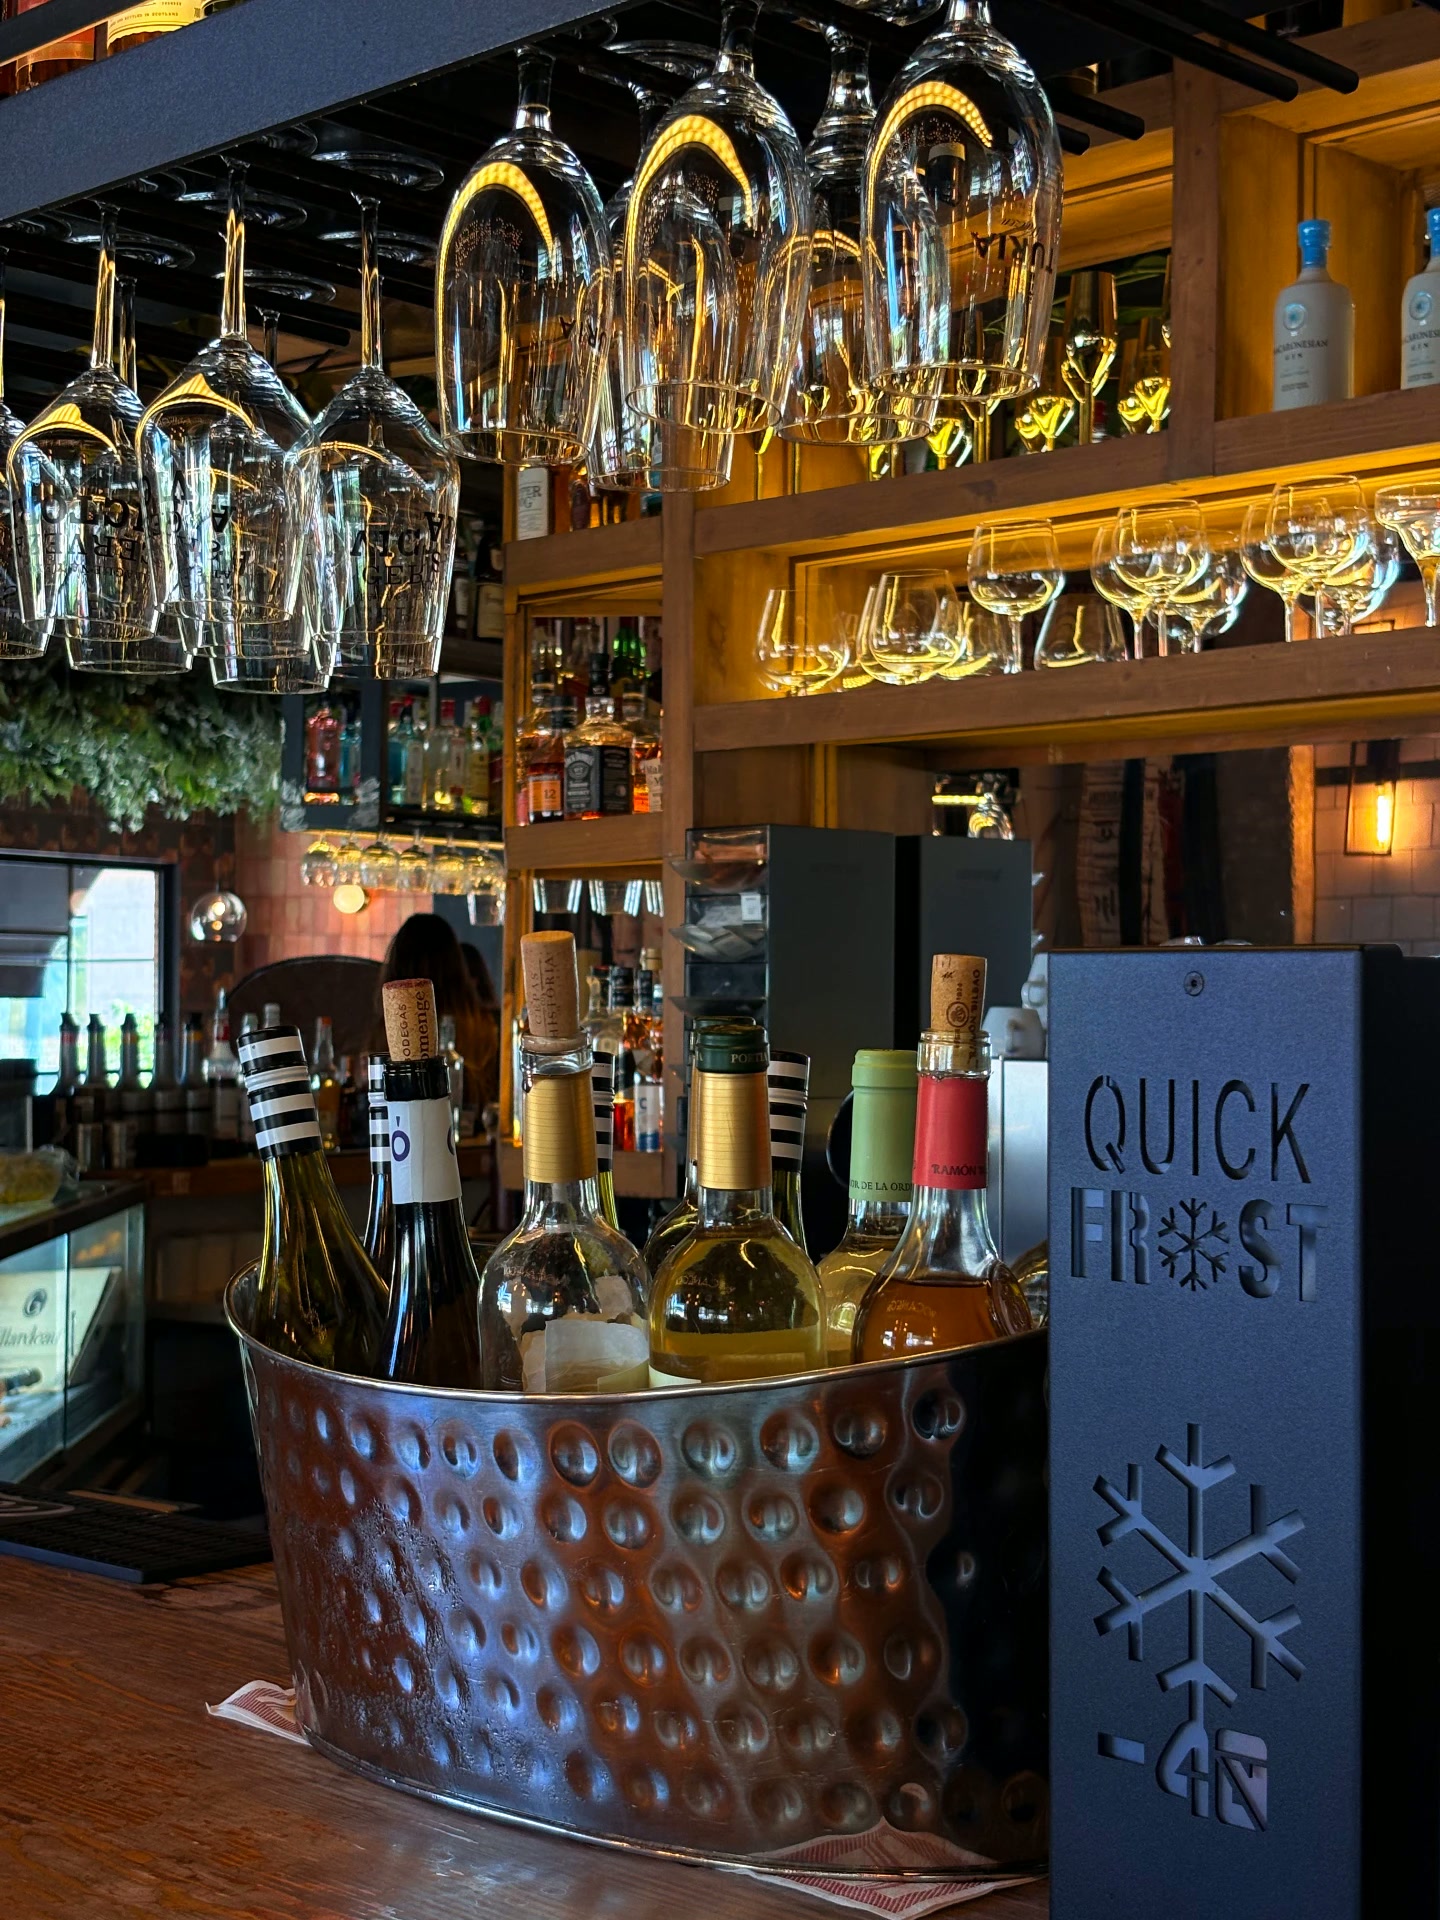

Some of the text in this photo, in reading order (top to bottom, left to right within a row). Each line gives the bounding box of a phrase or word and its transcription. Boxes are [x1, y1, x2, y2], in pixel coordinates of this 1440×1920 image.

[543, 788, 557, 800] 12
[530, 972, 543, 1025] CEPAS
[970, 968, 981, 1014] BILBAO
[1084, 1074, 1312, 1184] QUICK
[931, 1163, 977, 1176] RAMÓN
[861, 1180, 873, 1190] DE
[875, 1182, 888, 1191] LA
